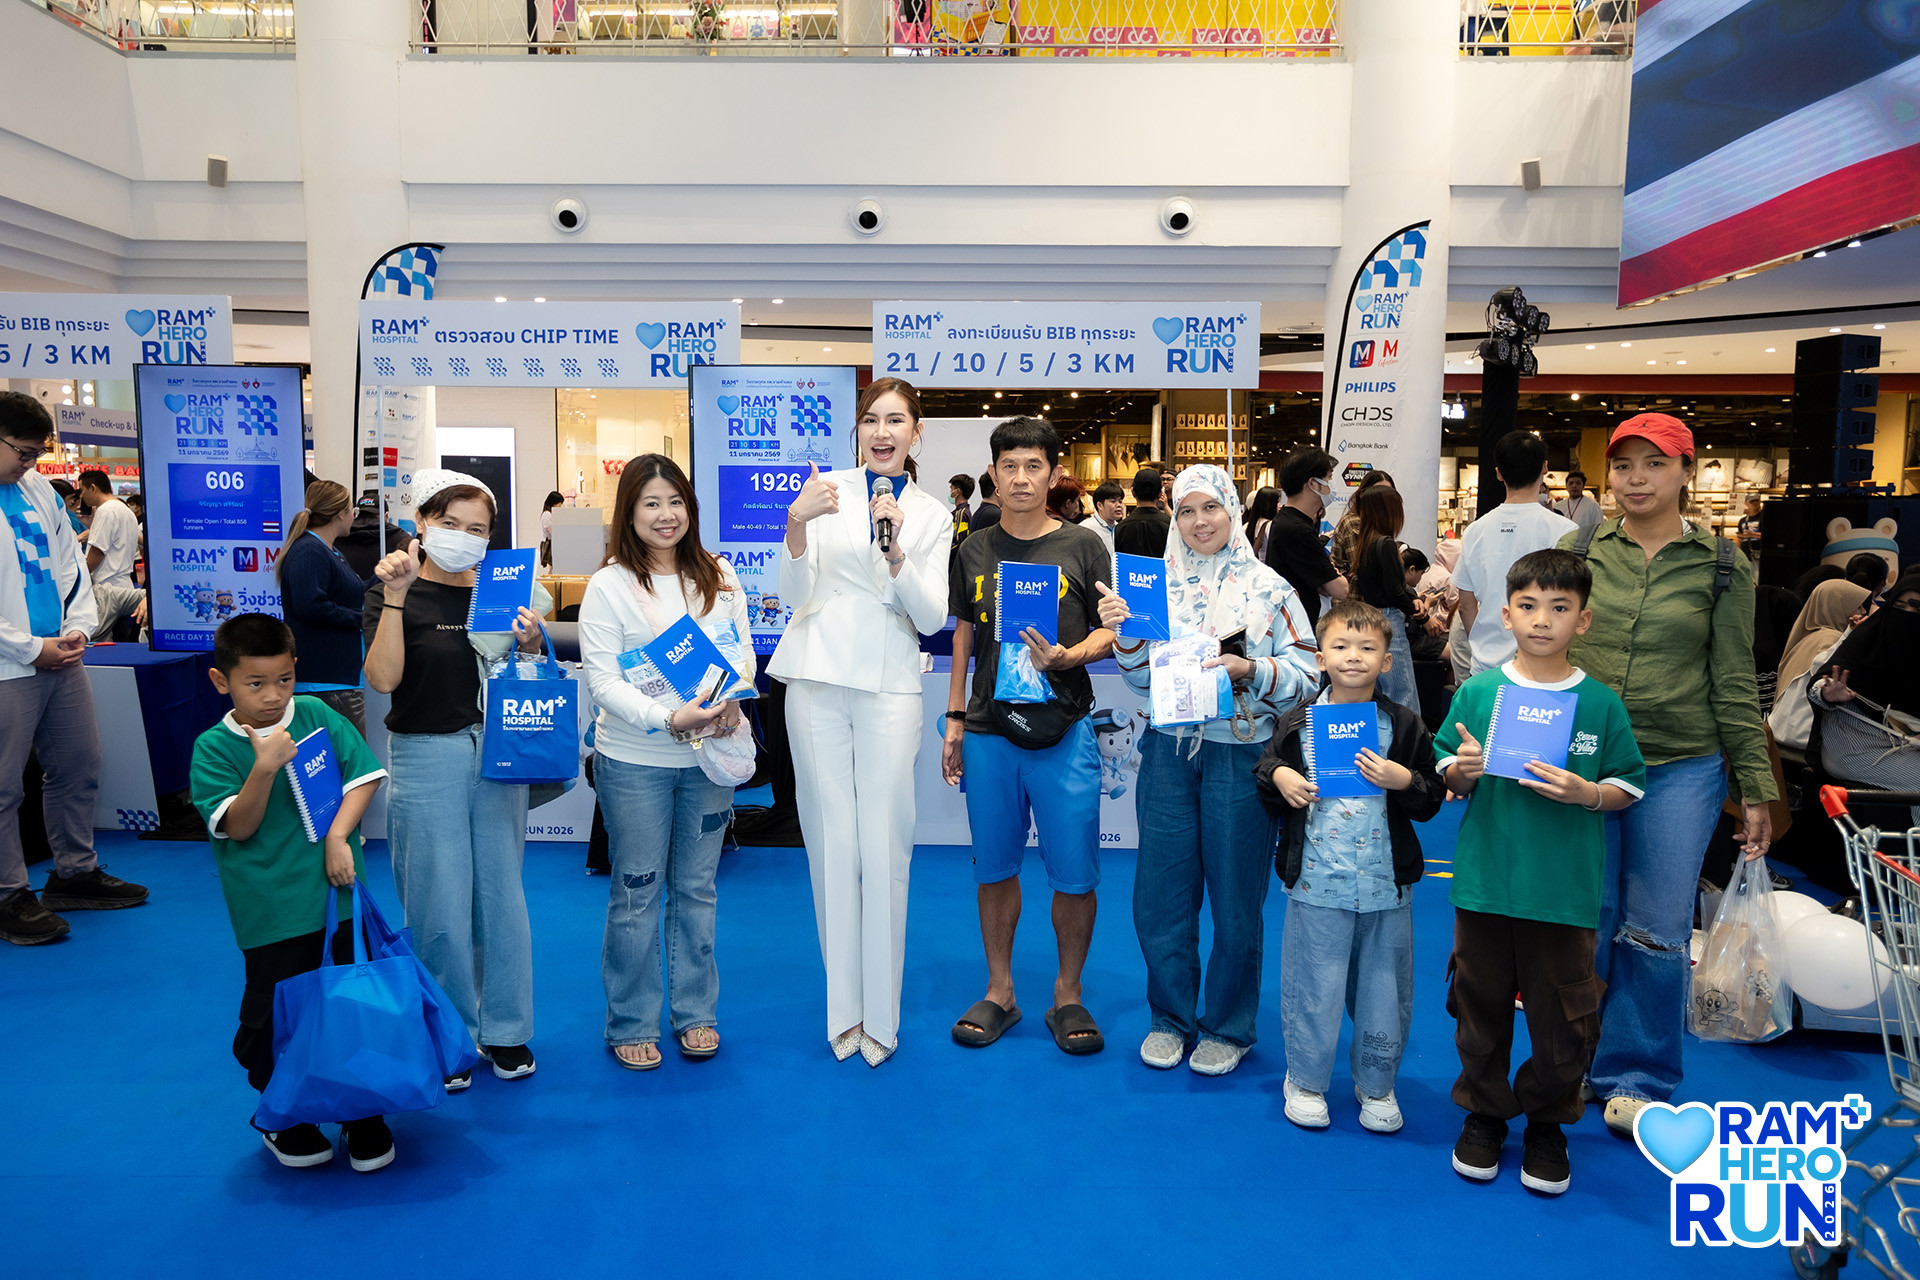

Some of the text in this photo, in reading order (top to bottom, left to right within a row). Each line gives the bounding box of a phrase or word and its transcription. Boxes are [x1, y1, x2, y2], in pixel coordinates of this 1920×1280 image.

[1374, 293, 1404, 304] RAM
[1373, 304, 1403, 313] HERO
[158, 310, 205, 326] RAM
[886, 314, 932, 330] RAM
[1186, 317, 1234, 333] RAM
[1361, 314, 1400, 329] RUN
[22, 318, 50, 331] BIB
[56, 320, 110, 337] ทุกระยะ
[159, 326, 207, 341] HERO
[372, 319, 418, 335] RAM
[668, 322, 714, 338] RAM
[948, 324, 1136, 345] ลงทะเบียนรับ BIB ทุกระยะ
[435, 329, 619, 344] ตรวจสอบ CHIP TIME
[1186, 334, 1236, 348] HERO
[142, 341, 206, 364] RUN
[668, 339, 716, 352] HERO
[1355, 344, 1371, 360] M
[1383, 339, 1398, 357] M
[22, 344, 32, 367] /
[44, 344, 59, 364] 3
[72, 346, 110, 365] KM
[1167, 349, 1234, 373] RUN
[887, 352, 1134, 376] 21 / 10 / 5 / 3 KM
[1345, 382, 1396, 394] PHILIPS
[188, 395, 222, 406] RAM
[741, 395, 776, 407] RAM
[62, 410, 82, 421] RAM
[188, 407, 224, 417] HERO
[741, 408, 777, 418] HERO
[90, 418, 125, 431] Check-up
[126, 420, 132, 431] &
[176, 417, 223, 435] RUN
[728, 418, 776, 436] RUN
[206, 471, 244, 490] 606
[750, 473, 802, 492] 1926
[172, 548, 217, 564] RAM
[493, 567, 519, 576] RAM
[1129, 572, 1153, 584] RAM
[1016, 581, 1041, 590] RAM
[665, 638, 692, 662] RAM
[672, 646, 694, 665] HOSPITAL
[503, 699, 554, 716] RAM
[1518, 706, 1553, 720] RAM
[503, 717, 554, 725] HOSPITAL
[1517, 716, 1551, 725] HOSPITAL
[1328, 723, 1359, 734] RAM
[304, 753, 325, 774] RAM
[1100, 833, 1121, 842] 026
